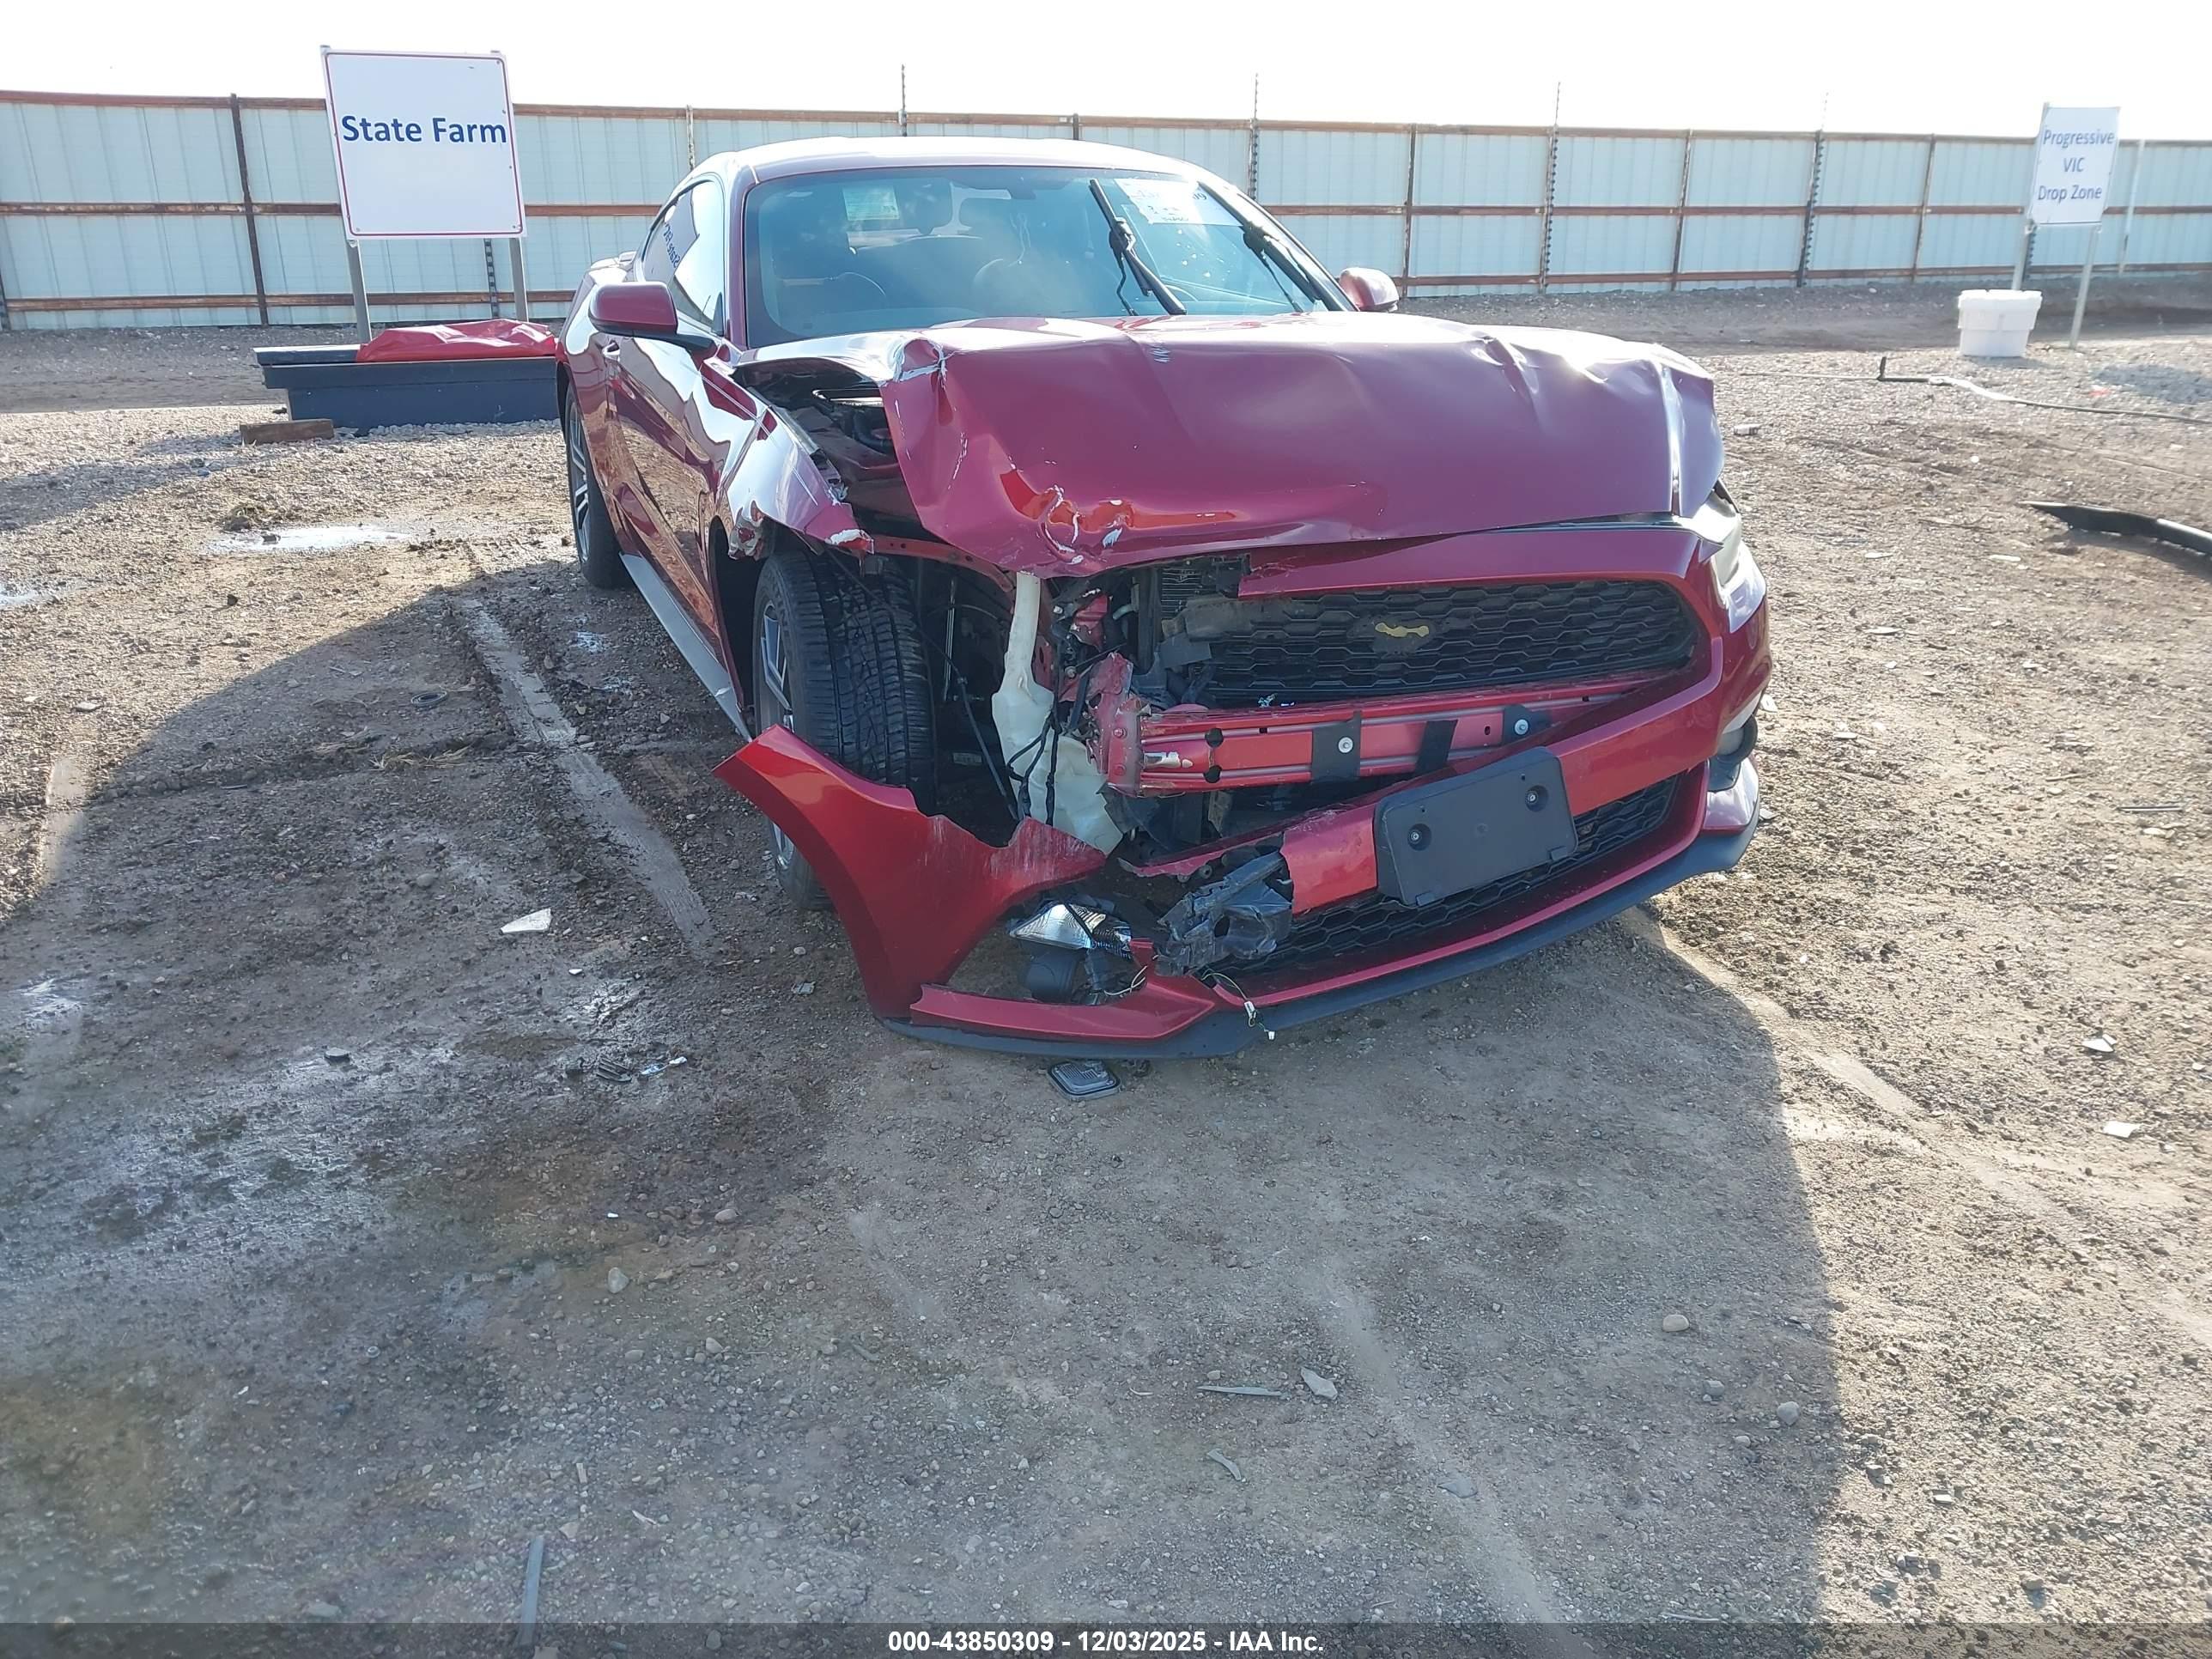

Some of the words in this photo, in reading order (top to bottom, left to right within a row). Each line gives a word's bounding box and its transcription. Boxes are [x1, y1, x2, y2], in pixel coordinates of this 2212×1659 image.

[341, 115, 422, 142] State
[432, 117, 507, 143] Farm
[2043, 129, 2115, 149] Progressive
[2063, 157, 2086, 173] VIC
[2037, 185, 2068, 204] Drop
[2070, 185, 2103, 200] Zone
